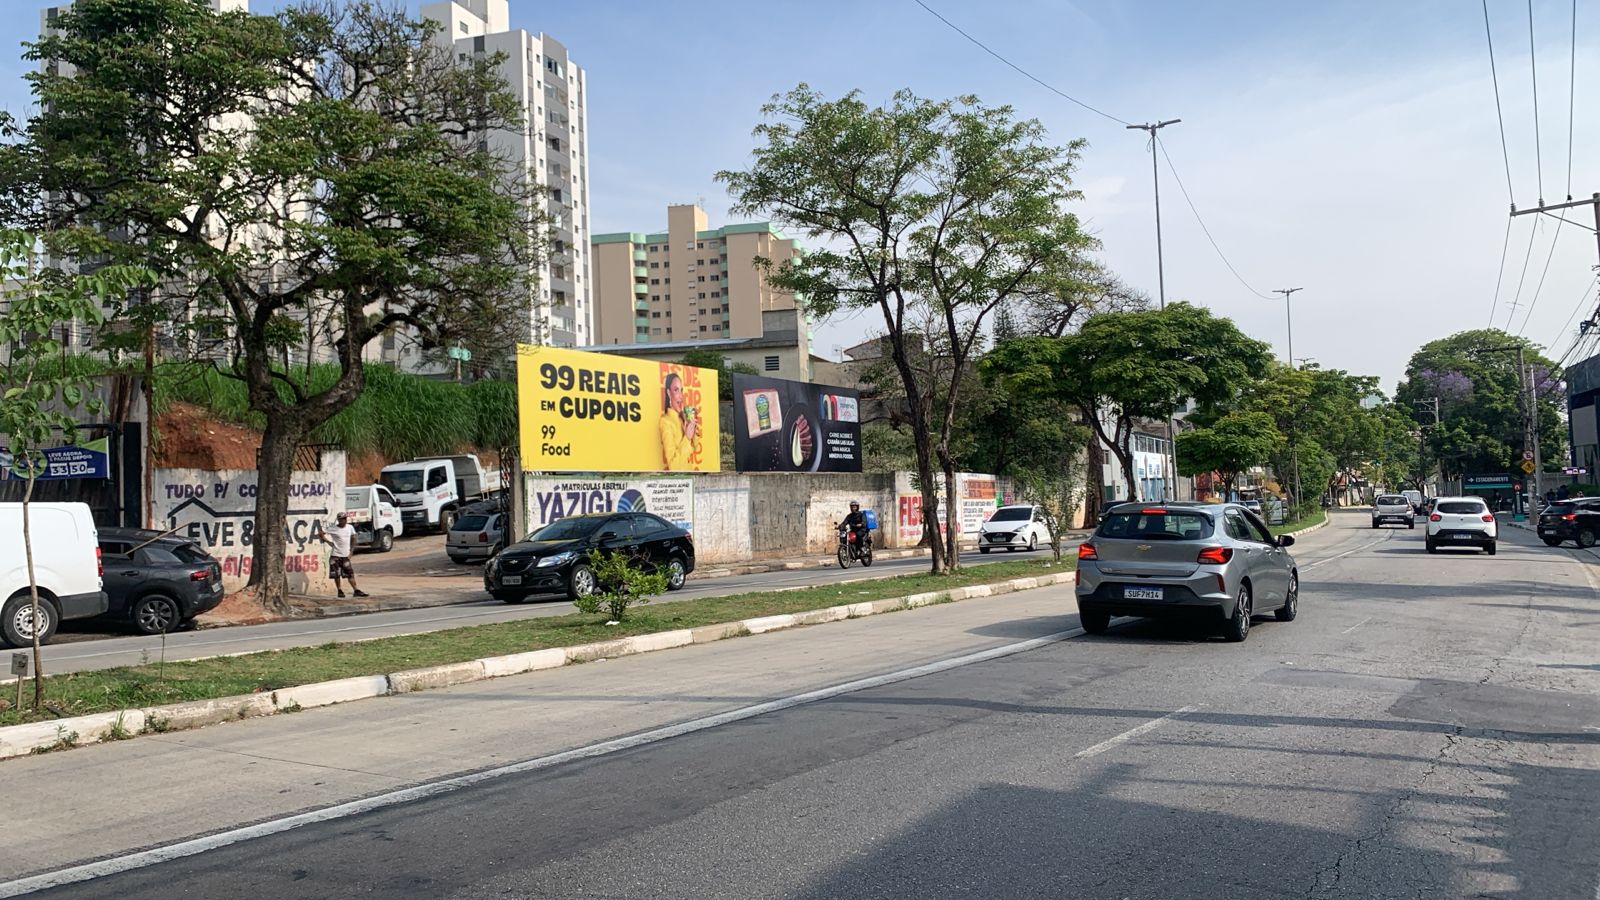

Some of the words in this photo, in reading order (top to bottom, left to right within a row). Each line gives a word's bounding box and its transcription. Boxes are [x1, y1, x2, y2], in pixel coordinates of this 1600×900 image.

[540, 362, 575, 391] 99
[578, 368, 641, 397] REAIS
[541, 400, 556, 412] EM
[559, 396, 641, 422] CUPONS
[541, 424, 556, 439] 99
[541, 442, 571, 456] Food
[52, 466, 67, 474] 33
[71, 464, 86, 473] 50
[165, 484, 205, 499] TUDO
[214, 482, 229, 498] P/
[561, 482, 601, 491] MATRÍCULAS
[602, 482, 628, 491] ABERTAS!
[536, 485, 613, 524] YÁZIGI
[240, 519, 254, 546] &
